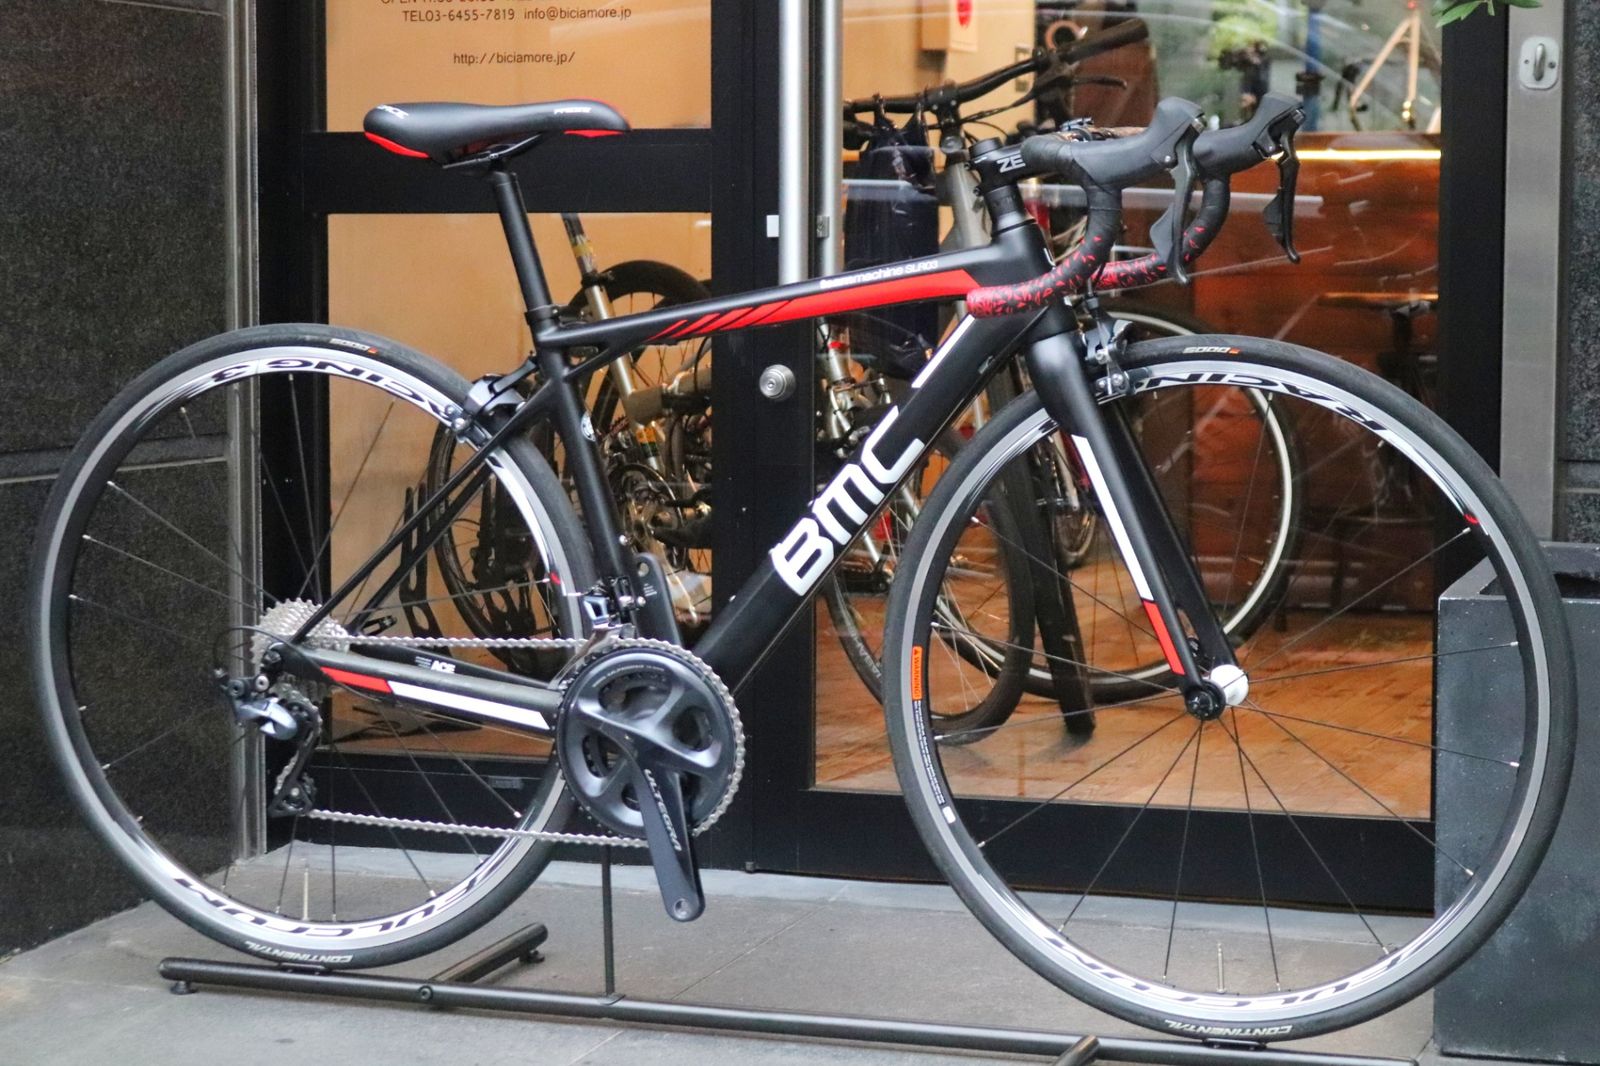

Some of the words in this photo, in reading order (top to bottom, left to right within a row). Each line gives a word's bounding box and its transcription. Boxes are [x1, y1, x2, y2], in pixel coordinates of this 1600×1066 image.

[402, 9, 515, 22] TEL03-6455-7819
[524, 7, 632, 20] info@biciamore.jp
[453, 51, 576, 65] http://biciamore.jp/
[266, 358, 456, 422] ACING
[1134, 373, 1387, 431] RACIN
[771, 405, 925, 596] BMC
[643, 768, 683, 852] ULTEGRA
[173, 876, 478, 937] FULCRUM
[244, 941, 353, 963] CONTINENTAL
[1165, 1019, 1293, 1036] CONTINENTAL
